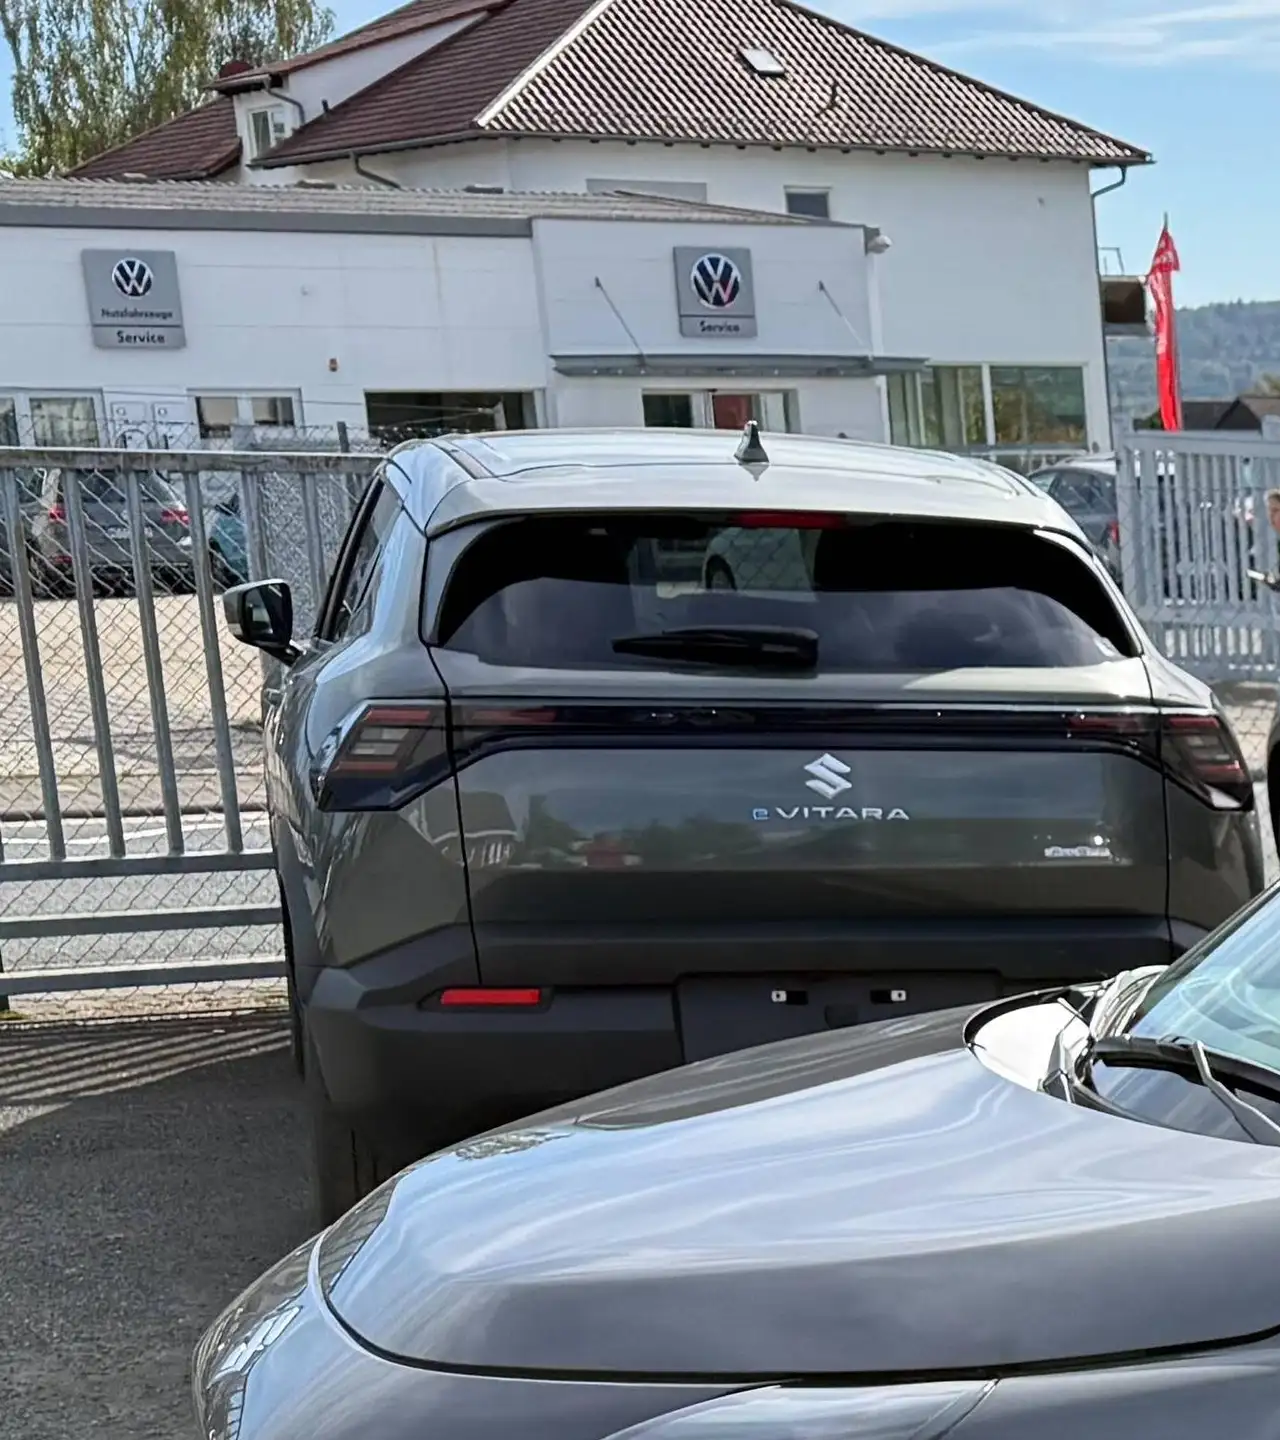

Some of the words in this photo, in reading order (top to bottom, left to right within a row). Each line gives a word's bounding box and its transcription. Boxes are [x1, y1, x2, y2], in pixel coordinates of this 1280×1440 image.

[699, 320, 740, 332] Service
[117, 331, 165, 343] Service
[775, 806, 909, 821] VITARA
